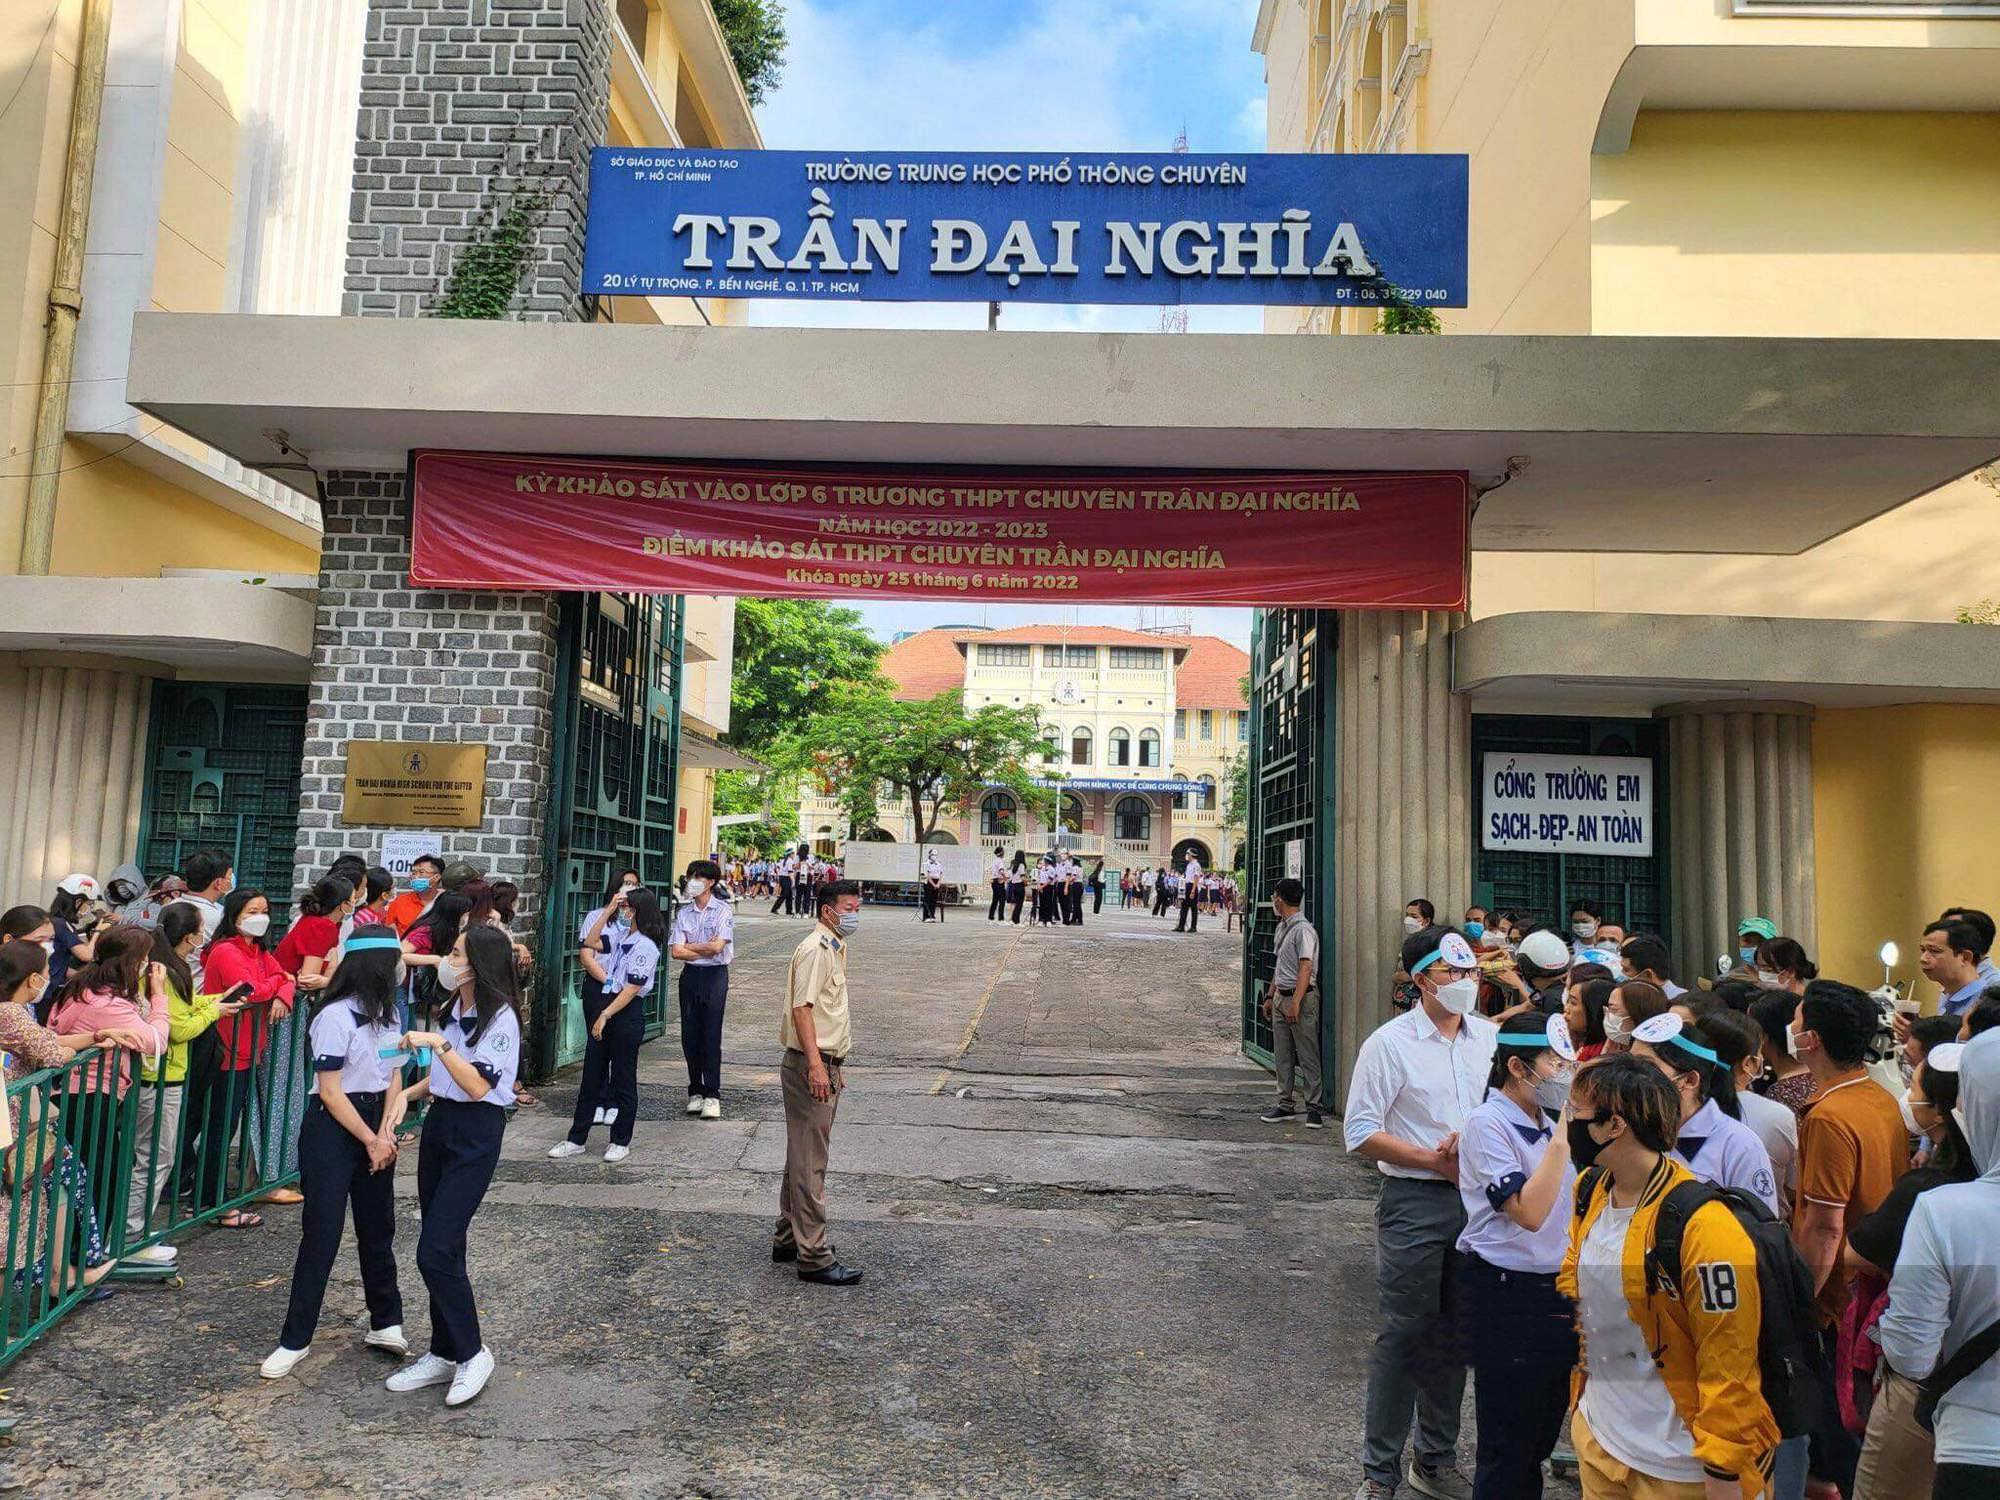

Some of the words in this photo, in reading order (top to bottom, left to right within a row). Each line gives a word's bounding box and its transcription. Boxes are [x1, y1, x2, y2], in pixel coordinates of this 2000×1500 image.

[626, 156, 652, 168] GIÁO
[655, 159, 675, 170] DỤC
[678, 157, 692, 168] VÀ
[694, 157, 716, 169] ĐÀO
[718, 160, 738, 171] TẠO
[635, 172, 647, 181] TP.
[666, 170, 684, 182] CHÍ
[686, 173, 711, 182] MINH
[806, 158, 892, 182] TRƯỜNG
[898, 164, 967, 183] TRUNG
[972, 164, 1022, 186] HỌC
[1027, 156, 1072, 184] PHỔ
[1078, 162, 1155, 184] THÔNG
[1160, 161, 1247, 185] CHUYÊN
[672, 187, 907, 273] TRẦN
[930, 219, 1080, 286] ĐẠI
[1104, 208, 1376, 276] NGHĨA
[602, 273, 622, 288] 20
[624, 274, 638, 288] LÝ
[640, 277, 656, 290] TỰ
[706, 279, 716, 290] P.
[720, 275, 740, 290] BẾN
[786, 281, 799, 292] Q.
[812, 282, 826, 292] TP.
[830, 282, 859, 293] HCM
[1425, 289, 1447, 300] 040
[516, 472, 553, 493] KỲ
[557, 472, 636, 498] KHẢO
[640, 476, 688, 499] SÁT
[694, 478, 750, 502] VÀO
[812, 486, 826, 504] 6
[951, 488, 1020, 508] THPT
[1024, 487, 1136, 510] CHUYÊN
[1220, 491, 1267, 518] ĐẠI
[1273, 486, 1360, 512] NGHĨA
[818, 514, 870, 535] NĂM
[874, 519, 922, 540] HỌC
[926, 520, 978, 538] 2022
[995, 522, 1049, 539] 2023
[642, 528, 706, 557] ĐIỂM
[712, 534, 785, 559] KHẢO
[790, 538, 838, 561] SÁT
[842, 544, 906, 563] THPT
[910, 542, 1014, 566] CHUYÊN
[1018, 540, 1088, 567] TRẦN
[1094, 549, 1138, 574] ĐẠI
[1144, 545, 1226, 569] NGHĨA
[786, 568, 834, 584] Khóa
[838, 570, 884, 588] ngày
[887, 571, 910, 586] 25
[913, 572, 969, 590] tháng
[972, 573, 983, 588] 6
[987, 573, 1028, 589] năm
[1032, 575, 1078, 590] 2022
[1494, 758, 1536, 799] CỔNG
[1546, 766, 1607, 802] TRƯỜNG
[1617, 774, 1640, 802] EM
[1601, 809, 1642, 844] TOÀN
[1697, 1263, 1738, 1312] 18
